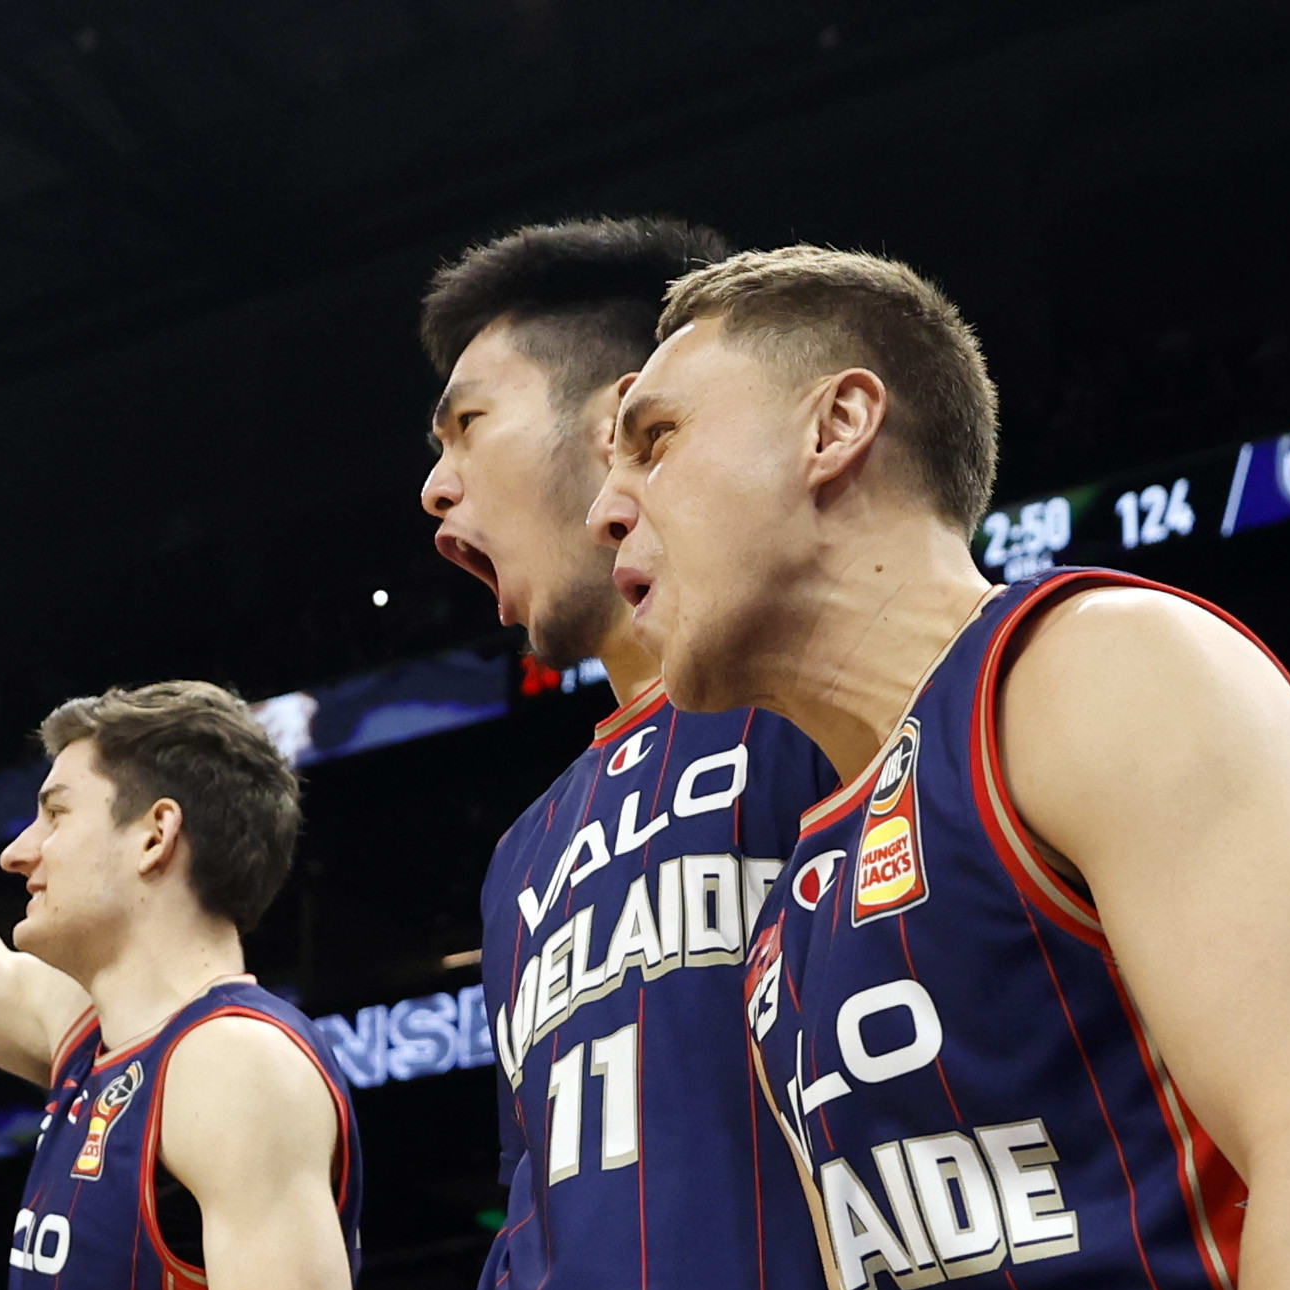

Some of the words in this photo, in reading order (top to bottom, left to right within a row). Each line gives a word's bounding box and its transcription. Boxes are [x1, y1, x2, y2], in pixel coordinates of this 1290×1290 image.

[983, 496, 1072, 568] 2:50
[1114, 476, 1197, 550] 124
[517, 742, 747, 936] VALO
[862, 834, 909, 866] HUNGRY
[547, 1022, 640, 1188] 11
